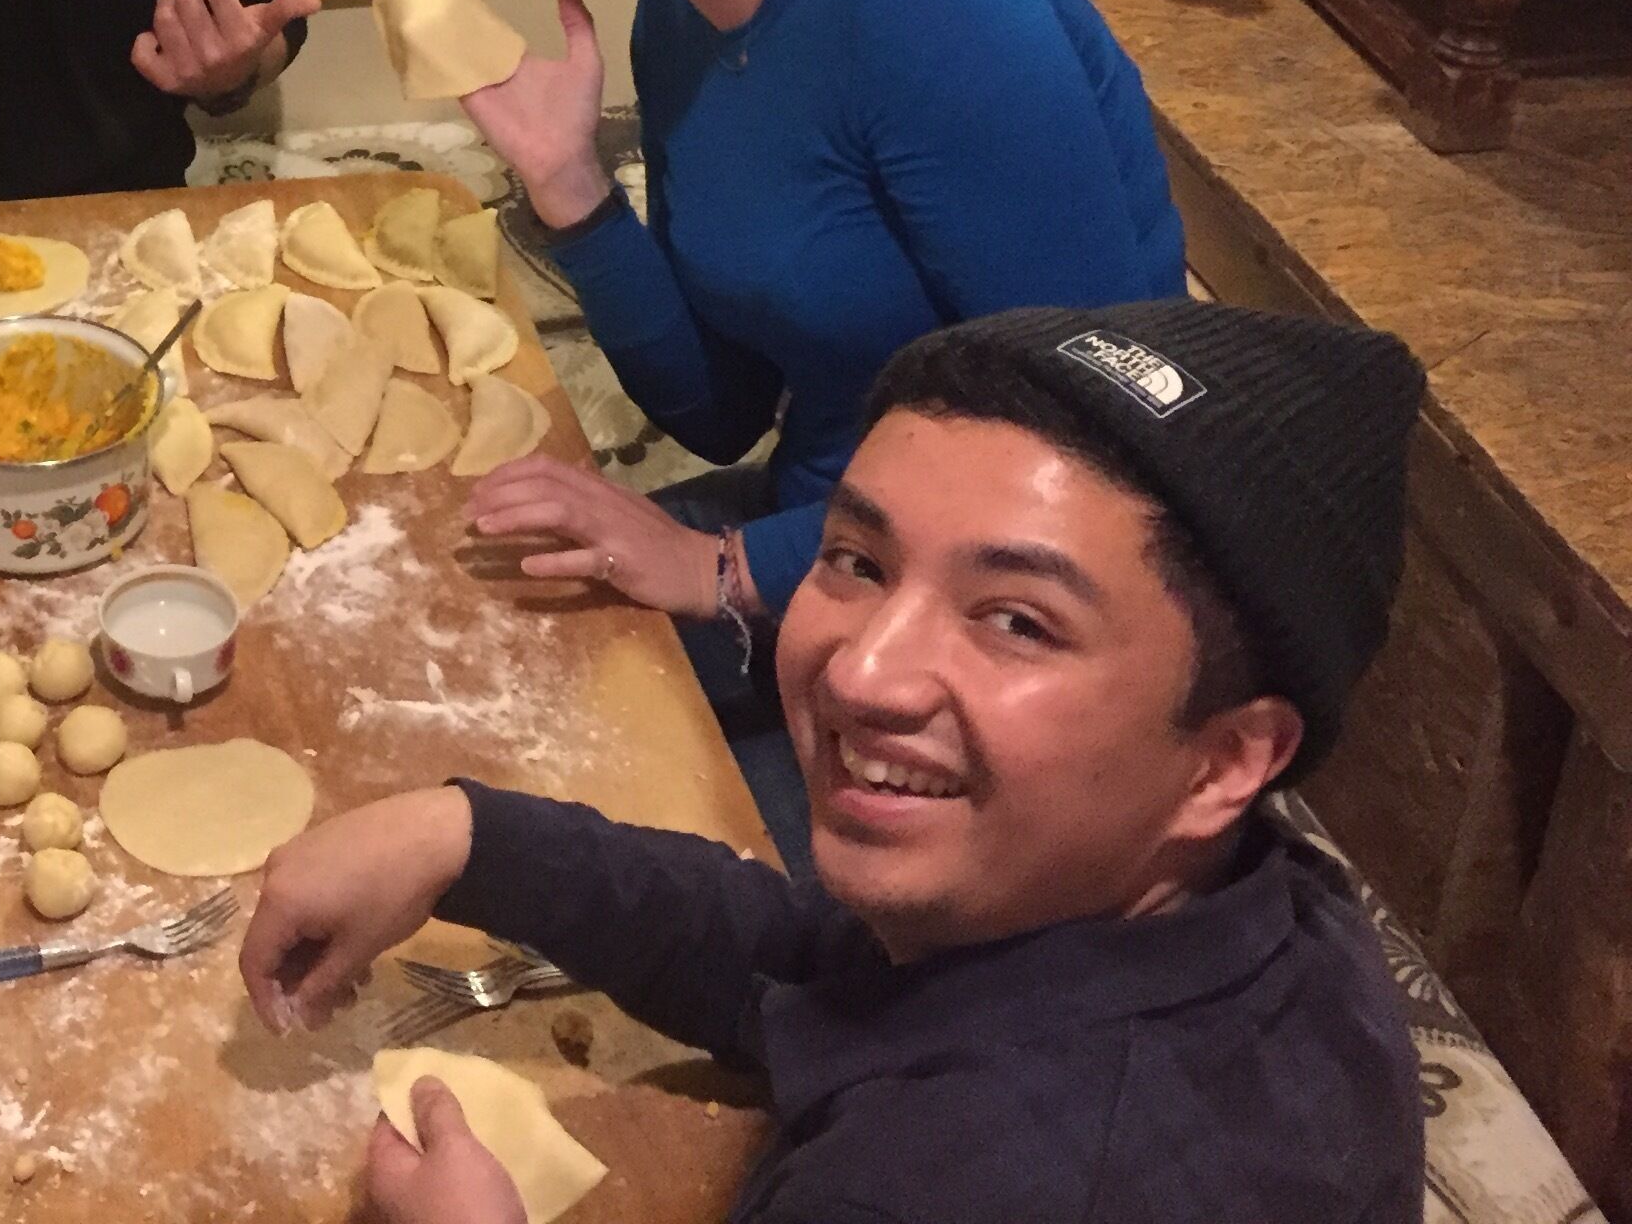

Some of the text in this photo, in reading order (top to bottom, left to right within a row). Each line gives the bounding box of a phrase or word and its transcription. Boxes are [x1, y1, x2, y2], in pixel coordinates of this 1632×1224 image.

[1085, 335, 1157, 376] NORTH
[1093, 350, 1145, 381] FACE
[1128, 344, 1164, 370] THE
